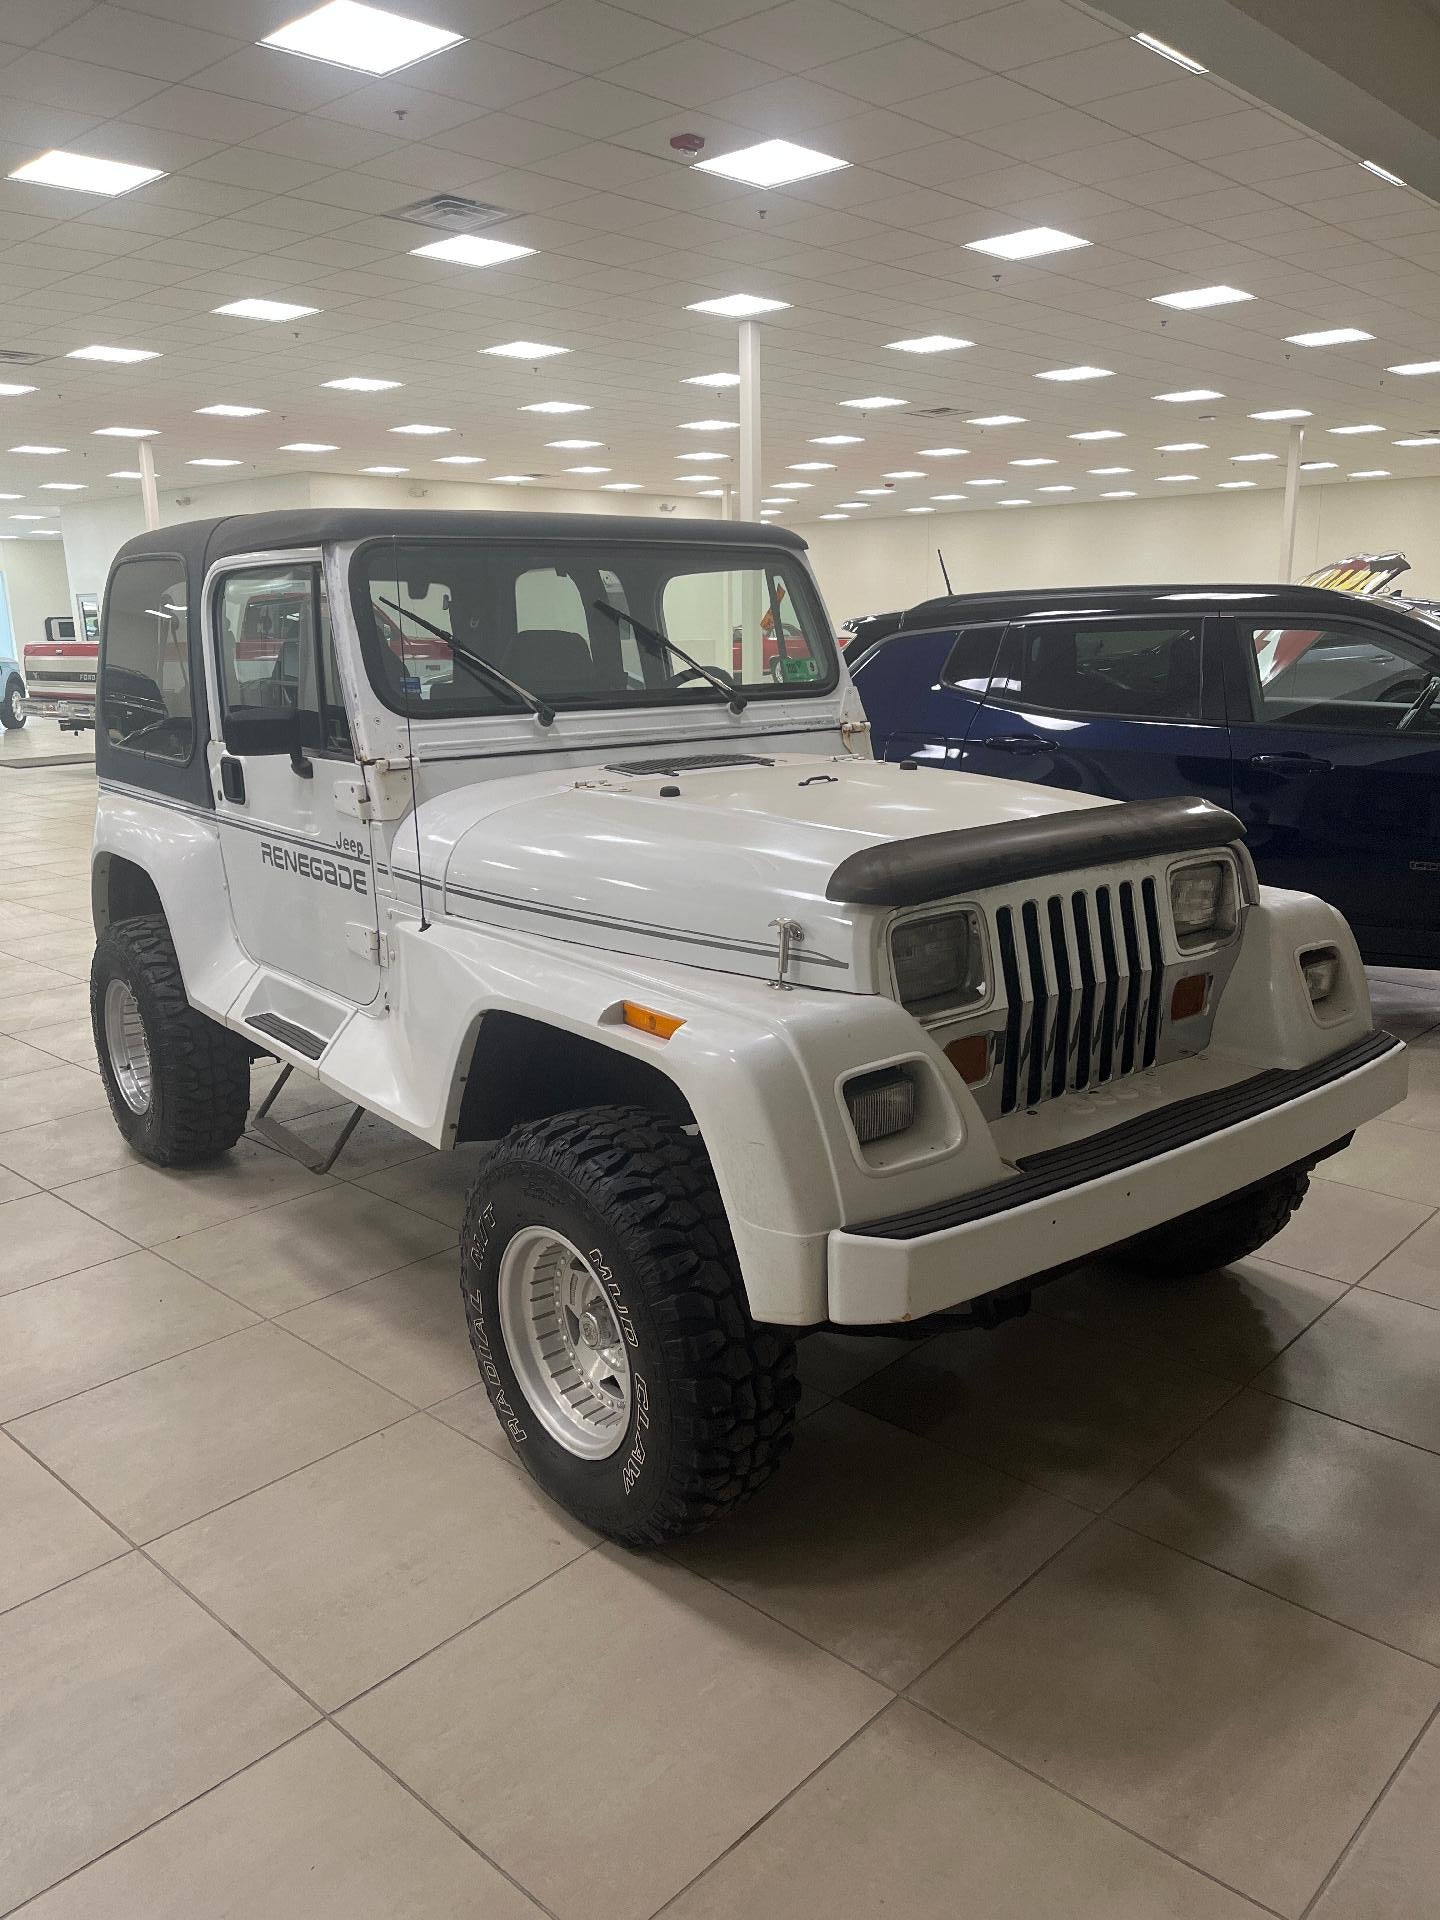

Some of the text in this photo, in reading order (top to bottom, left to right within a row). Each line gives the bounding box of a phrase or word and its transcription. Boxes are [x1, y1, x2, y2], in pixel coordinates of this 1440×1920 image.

[79, 673, 96, 681] FORD
[335, 831, 364, 858] Jeep
[470, 1289, 528, 1443] RADIAL
[588, 1248, 650, 1496] MUD CLAW
